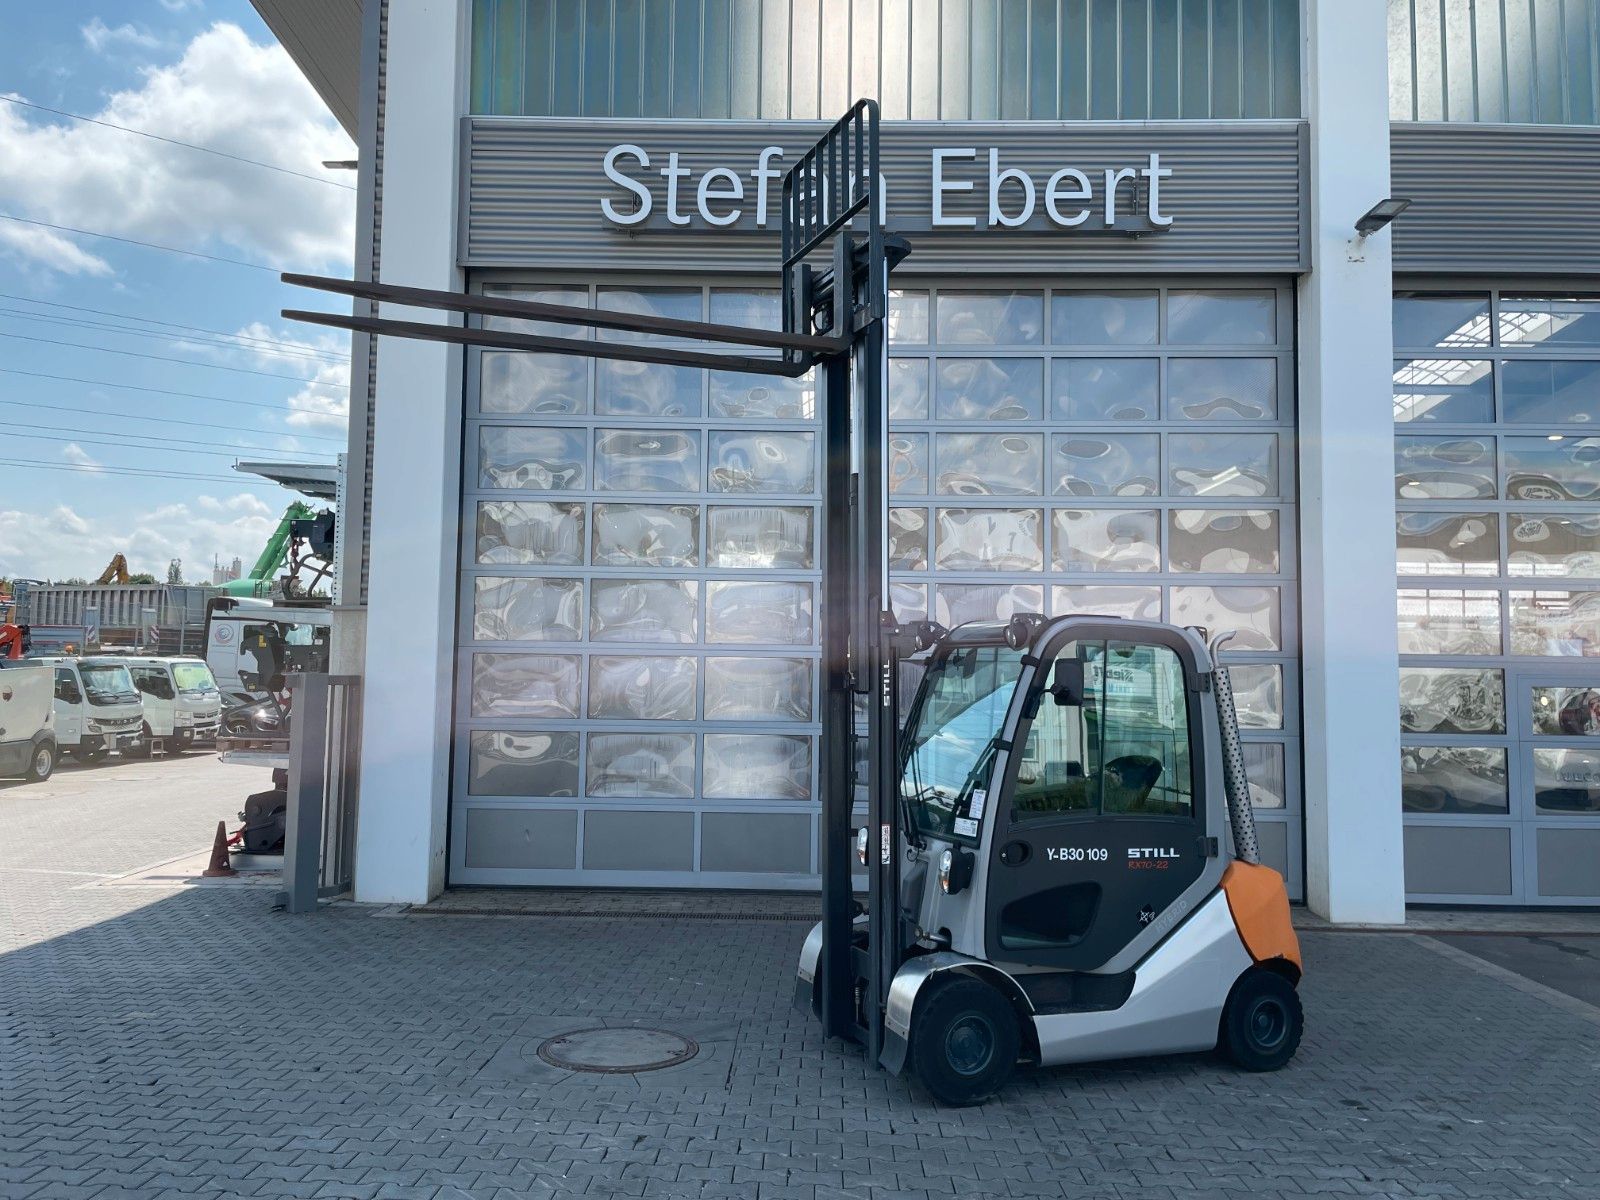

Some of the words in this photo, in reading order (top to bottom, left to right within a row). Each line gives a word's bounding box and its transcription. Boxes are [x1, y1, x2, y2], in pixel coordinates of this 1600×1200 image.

[931, 147, 1174, 227] Ebert
[1047, 848, 1084, 860] Y-B30
[1087, 848, 1108, 860] 109
[1128, 848, 1180, 858] STILL
[1128, 860, 1168, 869] RX70-22
